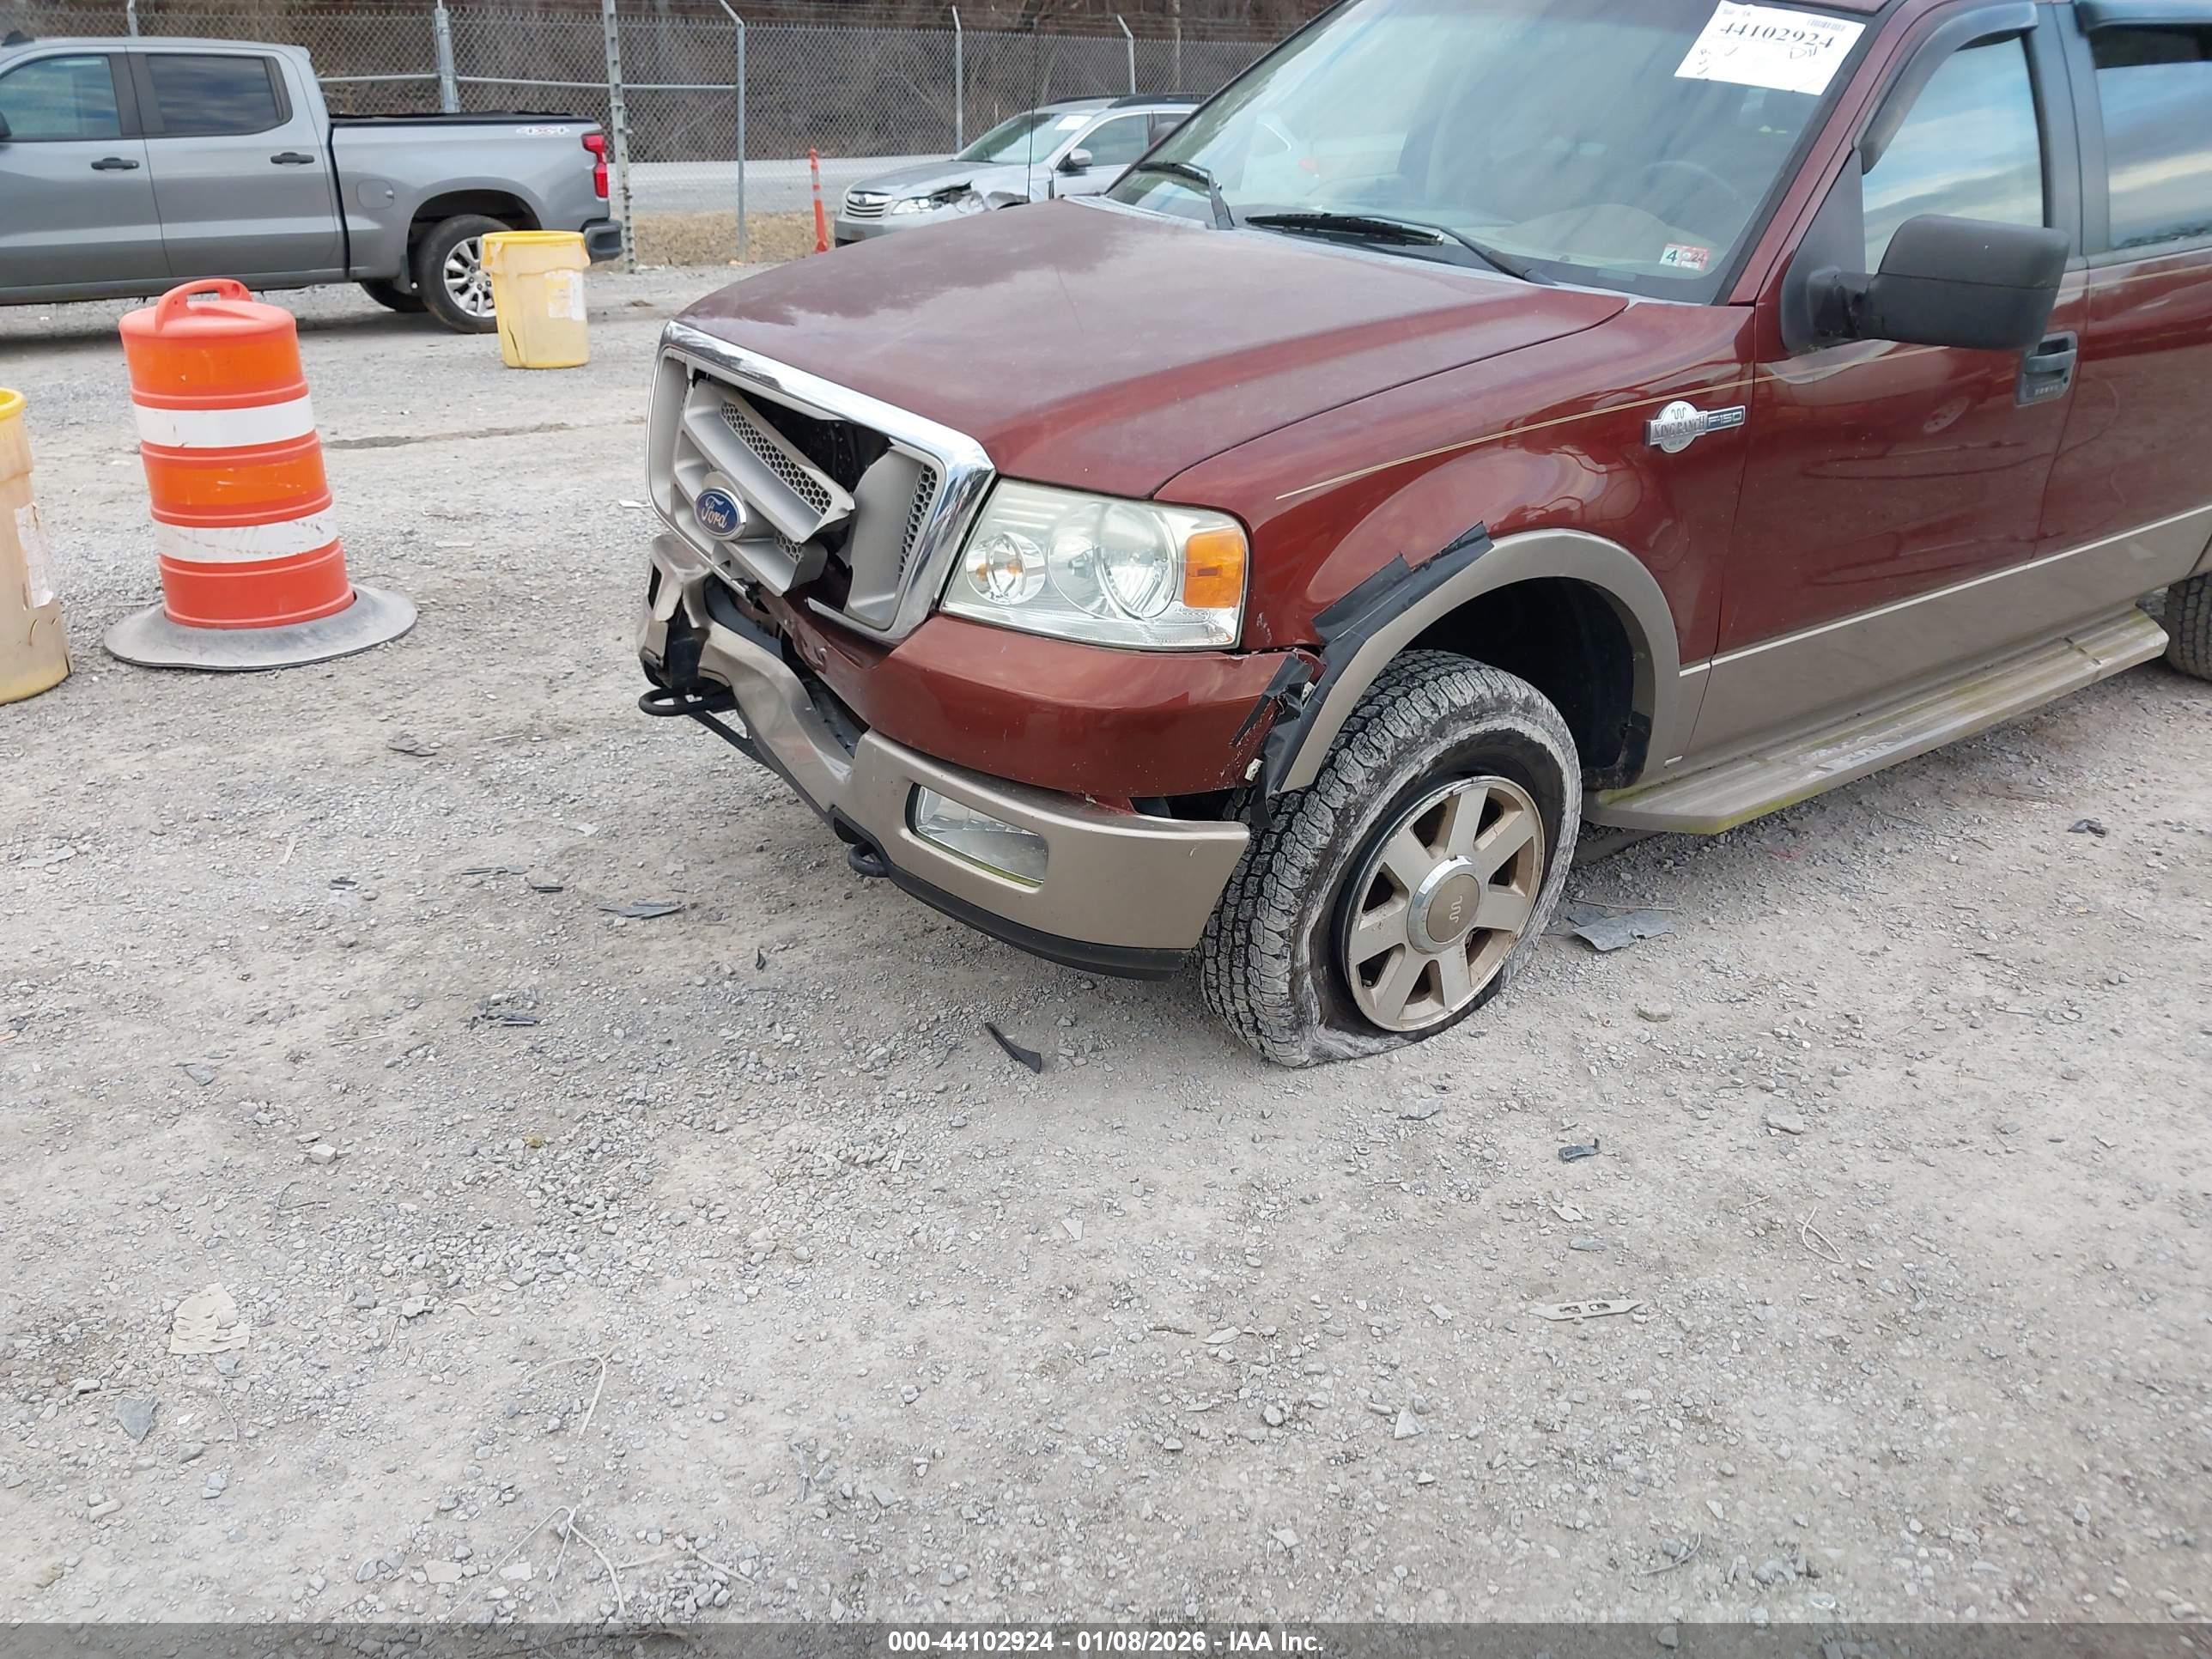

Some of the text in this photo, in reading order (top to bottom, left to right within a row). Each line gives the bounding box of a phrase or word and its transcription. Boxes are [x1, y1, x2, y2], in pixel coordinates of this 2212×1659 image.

[1720, 22, 1835, 48] 44102924
[1666, 249, 1678, 263] 4
[1690, 252, 1705, 263] 24
[1675, 415, 1705, 434] RANCH
[701, 495, 731, 529] Ford
